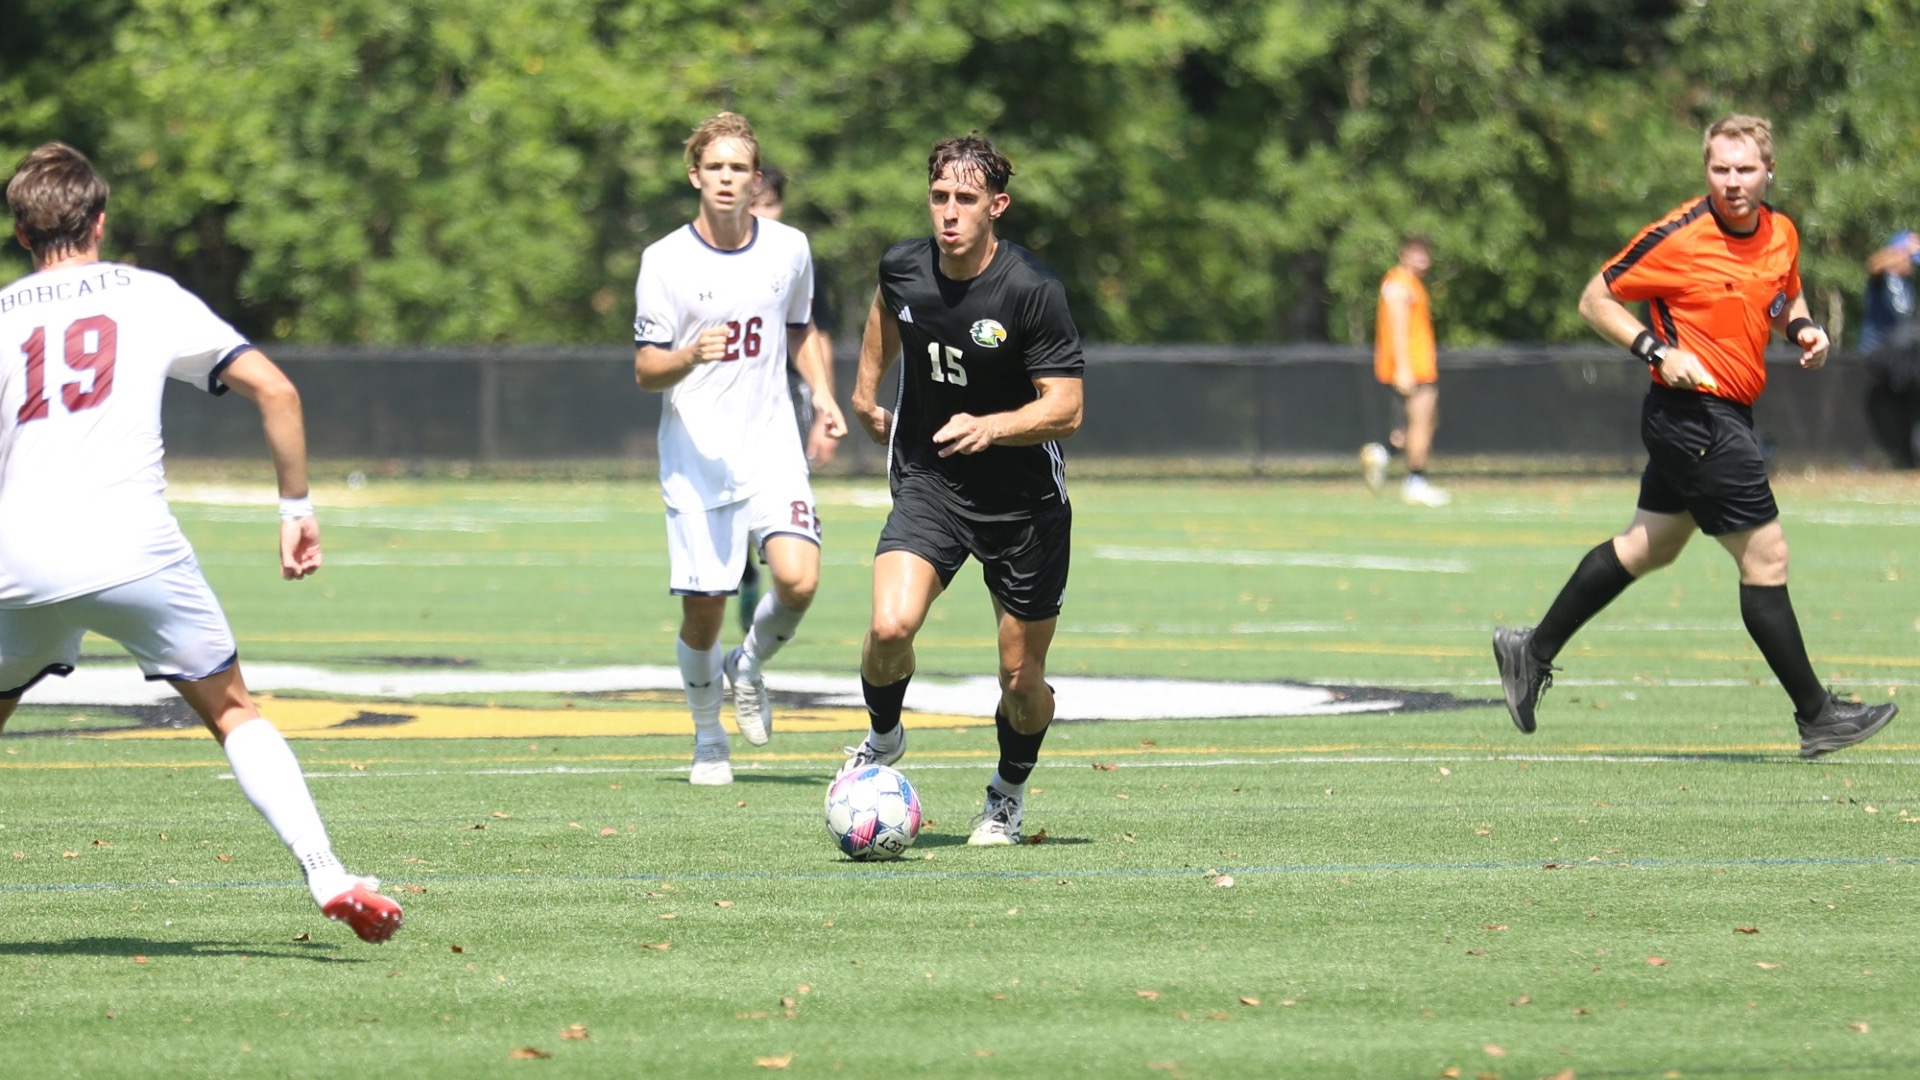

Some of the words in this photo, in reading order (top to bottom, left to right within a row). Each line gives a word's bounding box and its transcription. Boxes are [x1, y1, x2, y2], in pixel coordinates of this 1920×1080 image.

[1, 268, 131, 313] BOBCATS
[721, 316, 763, 362] 26
[17, 314, 117, 425] 19
[928, 342, 968, 387] 15
